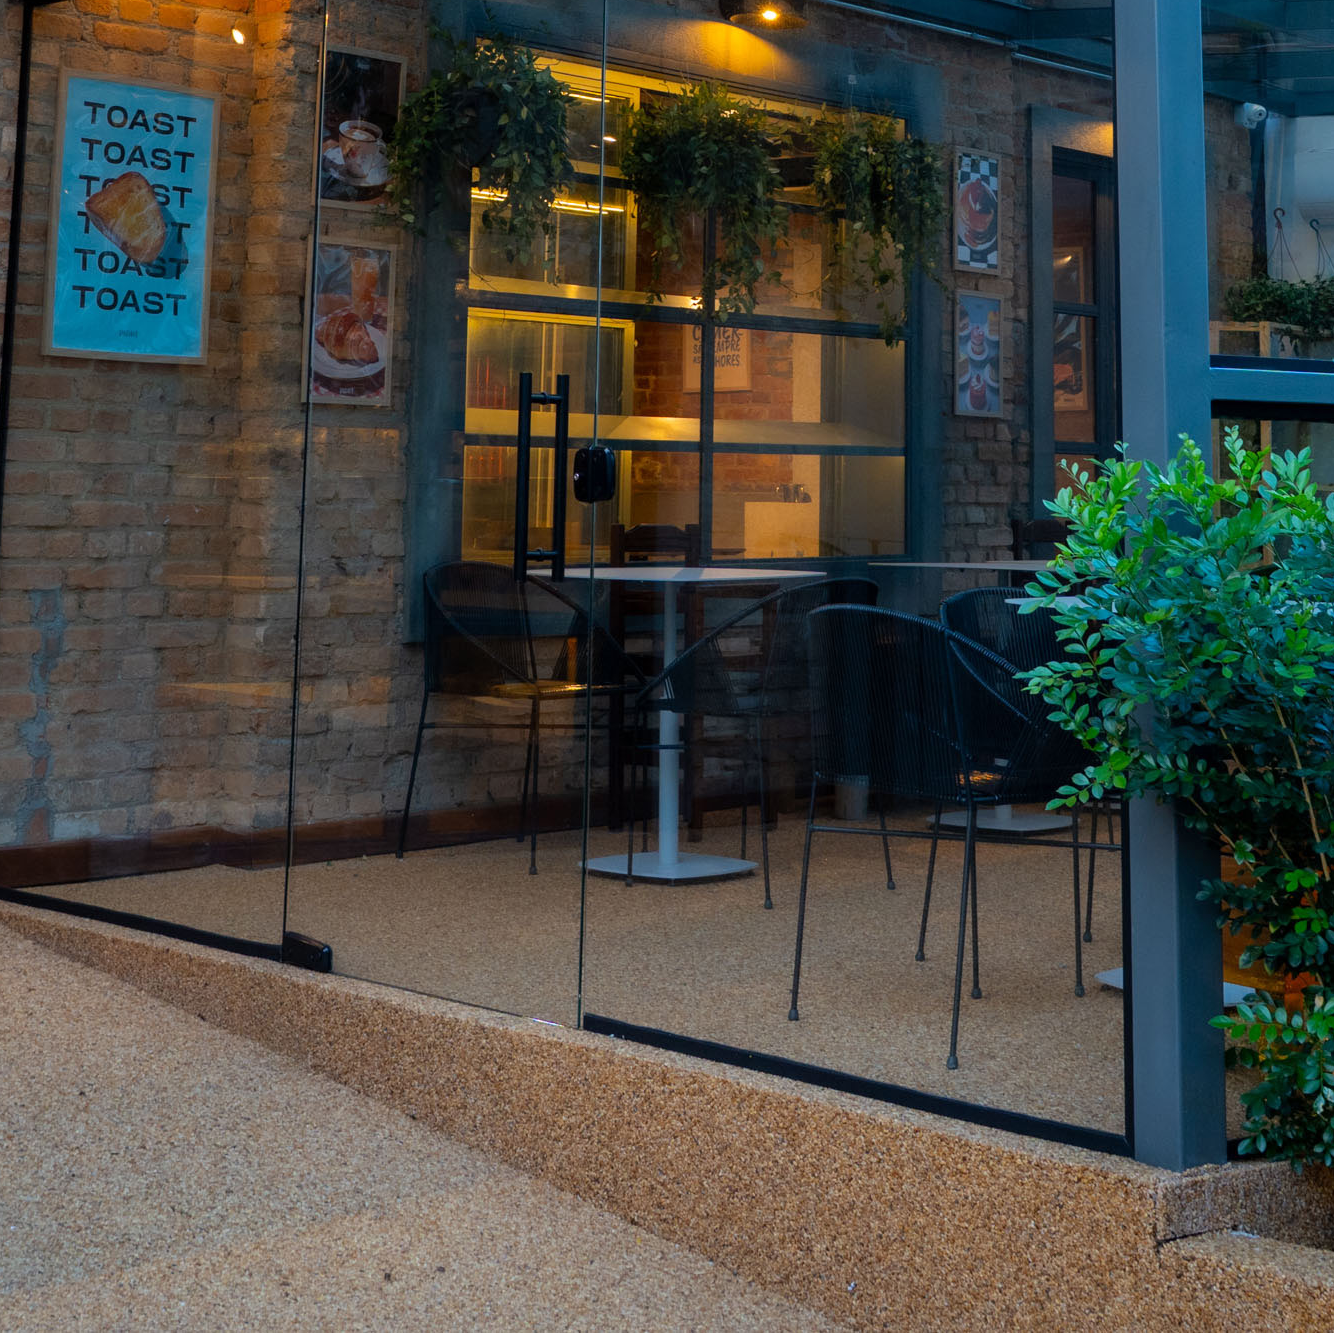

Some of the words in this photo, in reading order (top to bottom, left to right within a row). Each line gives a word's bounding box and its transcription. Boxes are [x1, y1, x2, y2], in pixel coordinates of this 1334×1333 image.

[84, 101, 197, 138] TOAST
[81, 138, 195, 173] TOAST
[79, 175, 192, 208] TST
[74, 248, 189, 280] TOAST
[72, 285, 187, 316] TOAST
